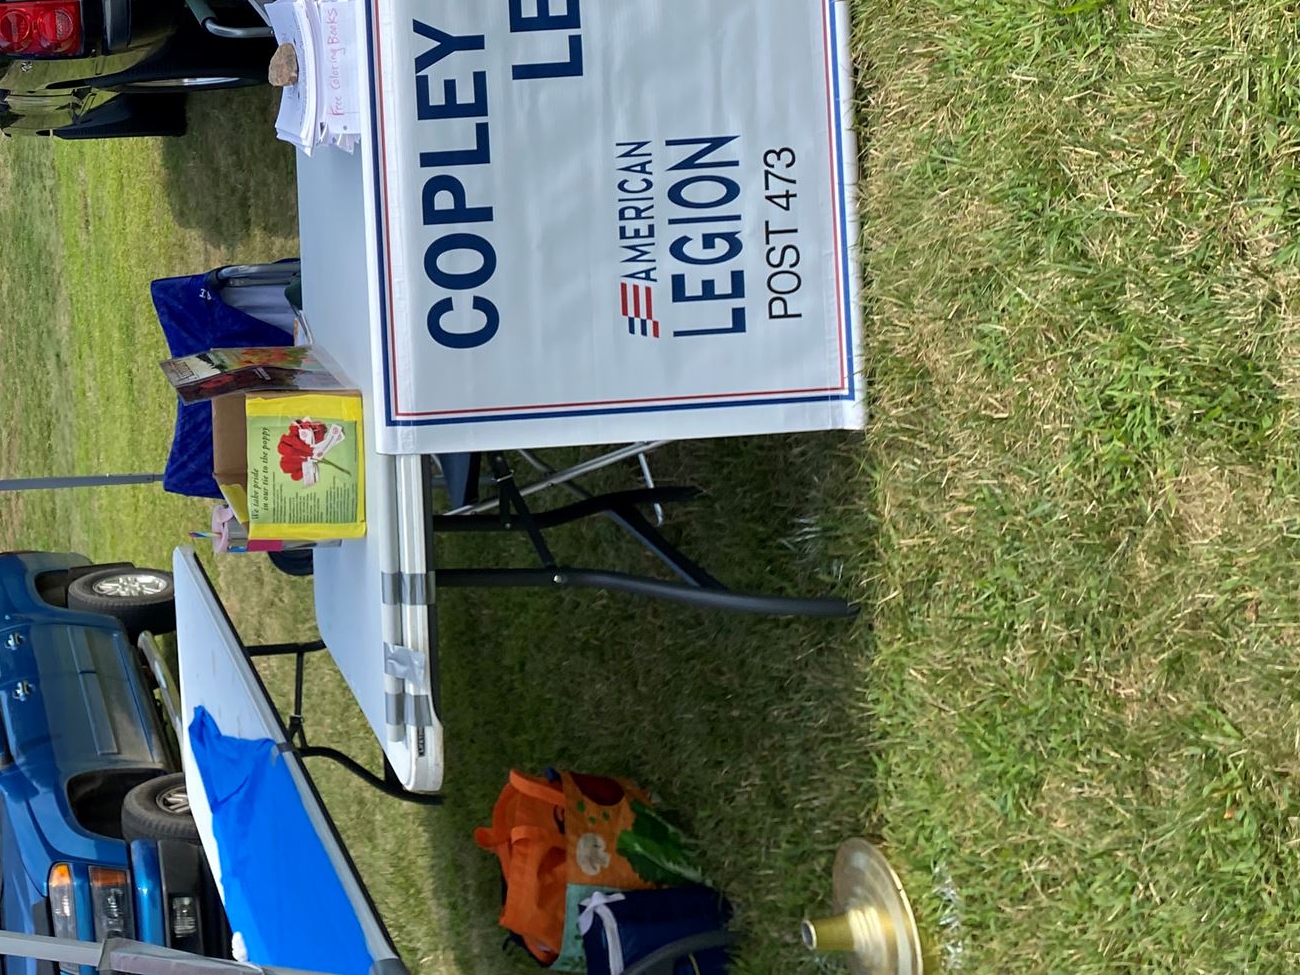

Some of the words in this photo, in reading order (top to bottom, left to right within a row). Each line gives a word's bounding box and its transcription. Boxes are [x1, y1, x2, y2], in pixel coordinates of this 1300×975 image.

[328, 48, 346, 89] Coloring
[331, 96, 345, 116] Free
[412, 19, 499, 349] COPLEY
[763, 146, 797, 211] 473
[616, 140, 658, 283] AMERICAN
[665, 134, 746, 337] LEGION
[765, 219, 802, 319] POST
[261, 426, 270, 451] poppy
[260, 452, 269, 463] the
[251, 468, 261, 489] pride
[262, 465, 269, 473] to
[261, 475, 269, 485] tie
[251, 491, 259, 507] take
[261, 502, 269, 511] in
[251, 509, 259, 520] We
